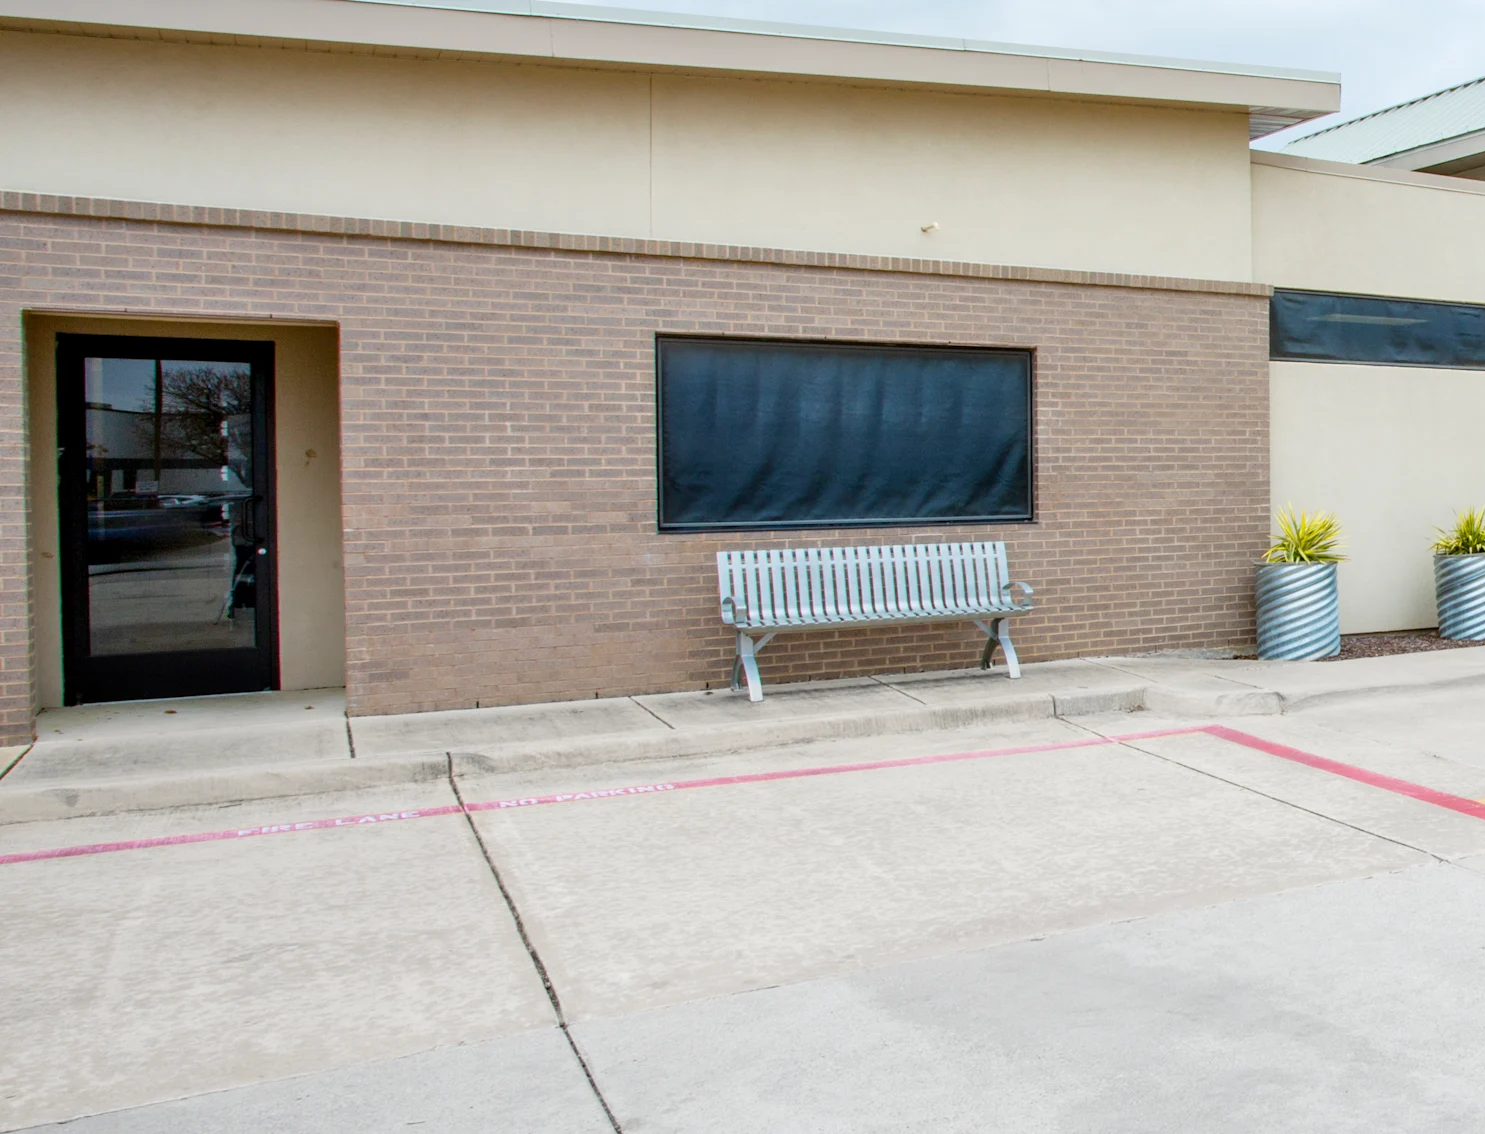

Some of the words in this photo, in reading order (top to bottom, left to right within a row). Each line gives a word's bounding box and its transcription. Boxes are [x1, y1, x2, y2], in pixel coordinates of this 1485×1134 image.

[237, 822, 314, 837] FIRE
[335, 811, 420, 826] LANE
[500, 798, 538, 808] NO
[555, 783, 675, 802] PARKING
